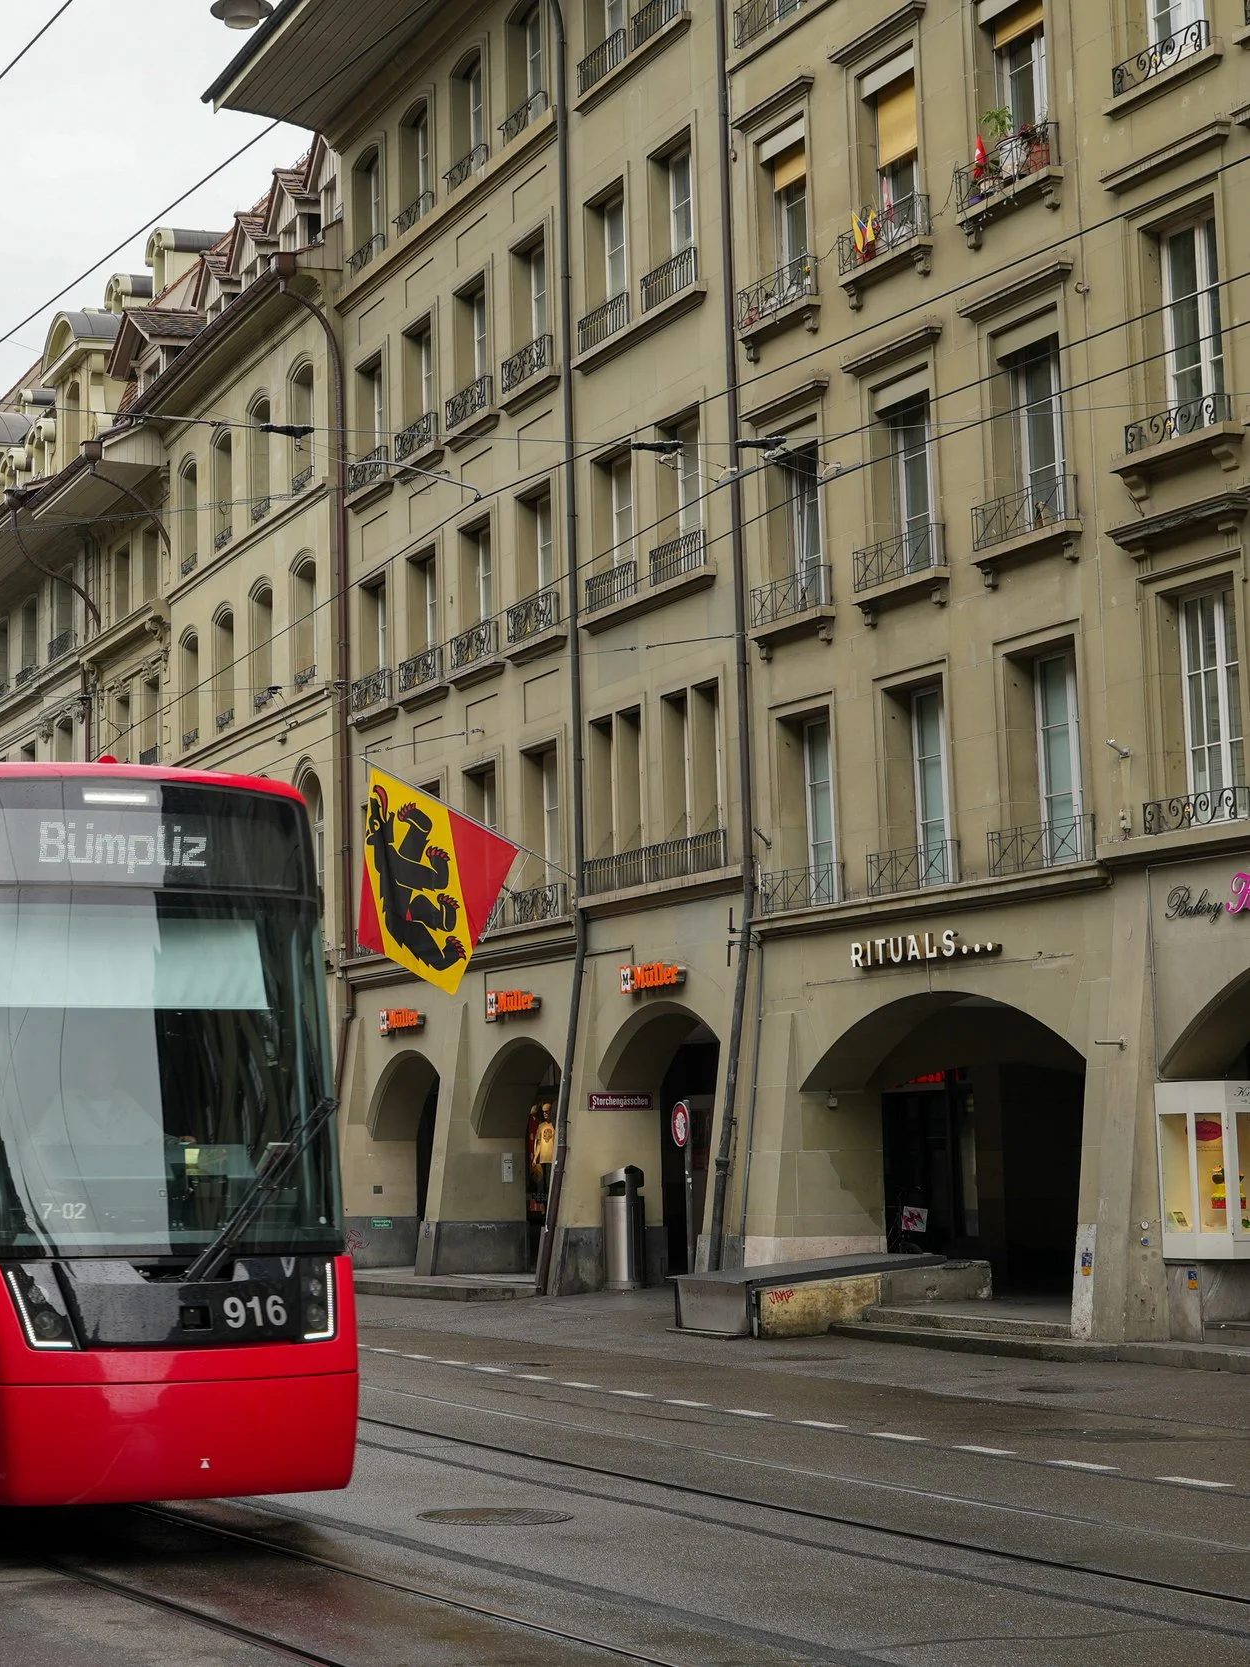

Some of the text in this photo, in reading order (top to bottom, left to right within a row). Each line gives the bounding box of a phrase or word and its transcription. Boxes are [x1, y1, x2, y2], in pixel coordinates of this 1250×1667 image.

[39, 821, 207, 874] Bümpliz
[1165, 886, 1223, 924] Bakery
[633, 962, 678, 990] Müller
[497, 989, 534, 1012] Müller
[388, 1008, 418, 1028] Müller
[592, 1095, 649, 1108] Storchengässchen
[41, 1203, 87, 1220] 7-02
[223, 1295, 287, 1329] 916
